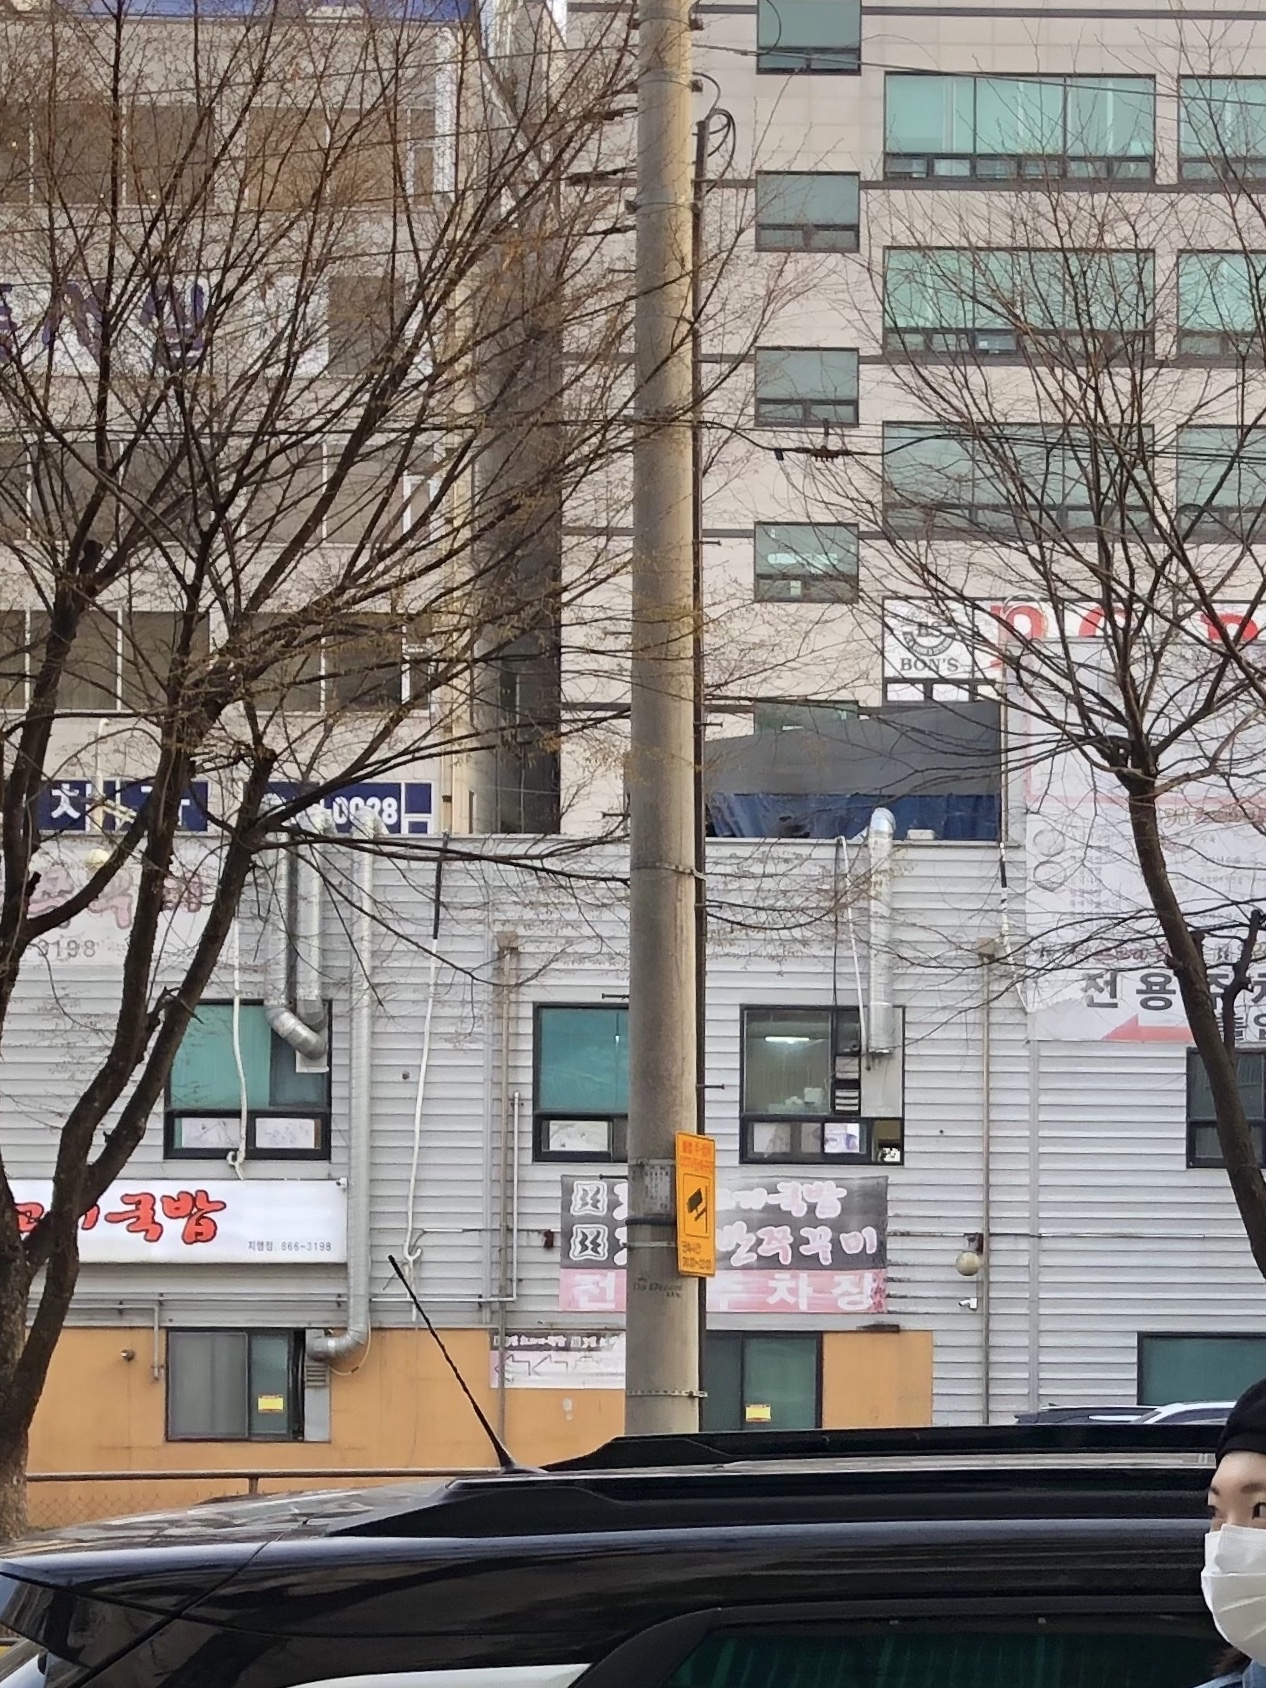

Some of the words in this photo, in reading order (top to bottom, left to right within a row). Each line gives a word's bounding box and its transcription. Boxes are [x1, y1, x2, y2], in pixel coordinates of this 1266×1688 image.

[900, 658, 959, 672] BON'S
[16, 1190, 227, 1245] 고국밥
[281, 1242, 332, 1252] 866-3198
